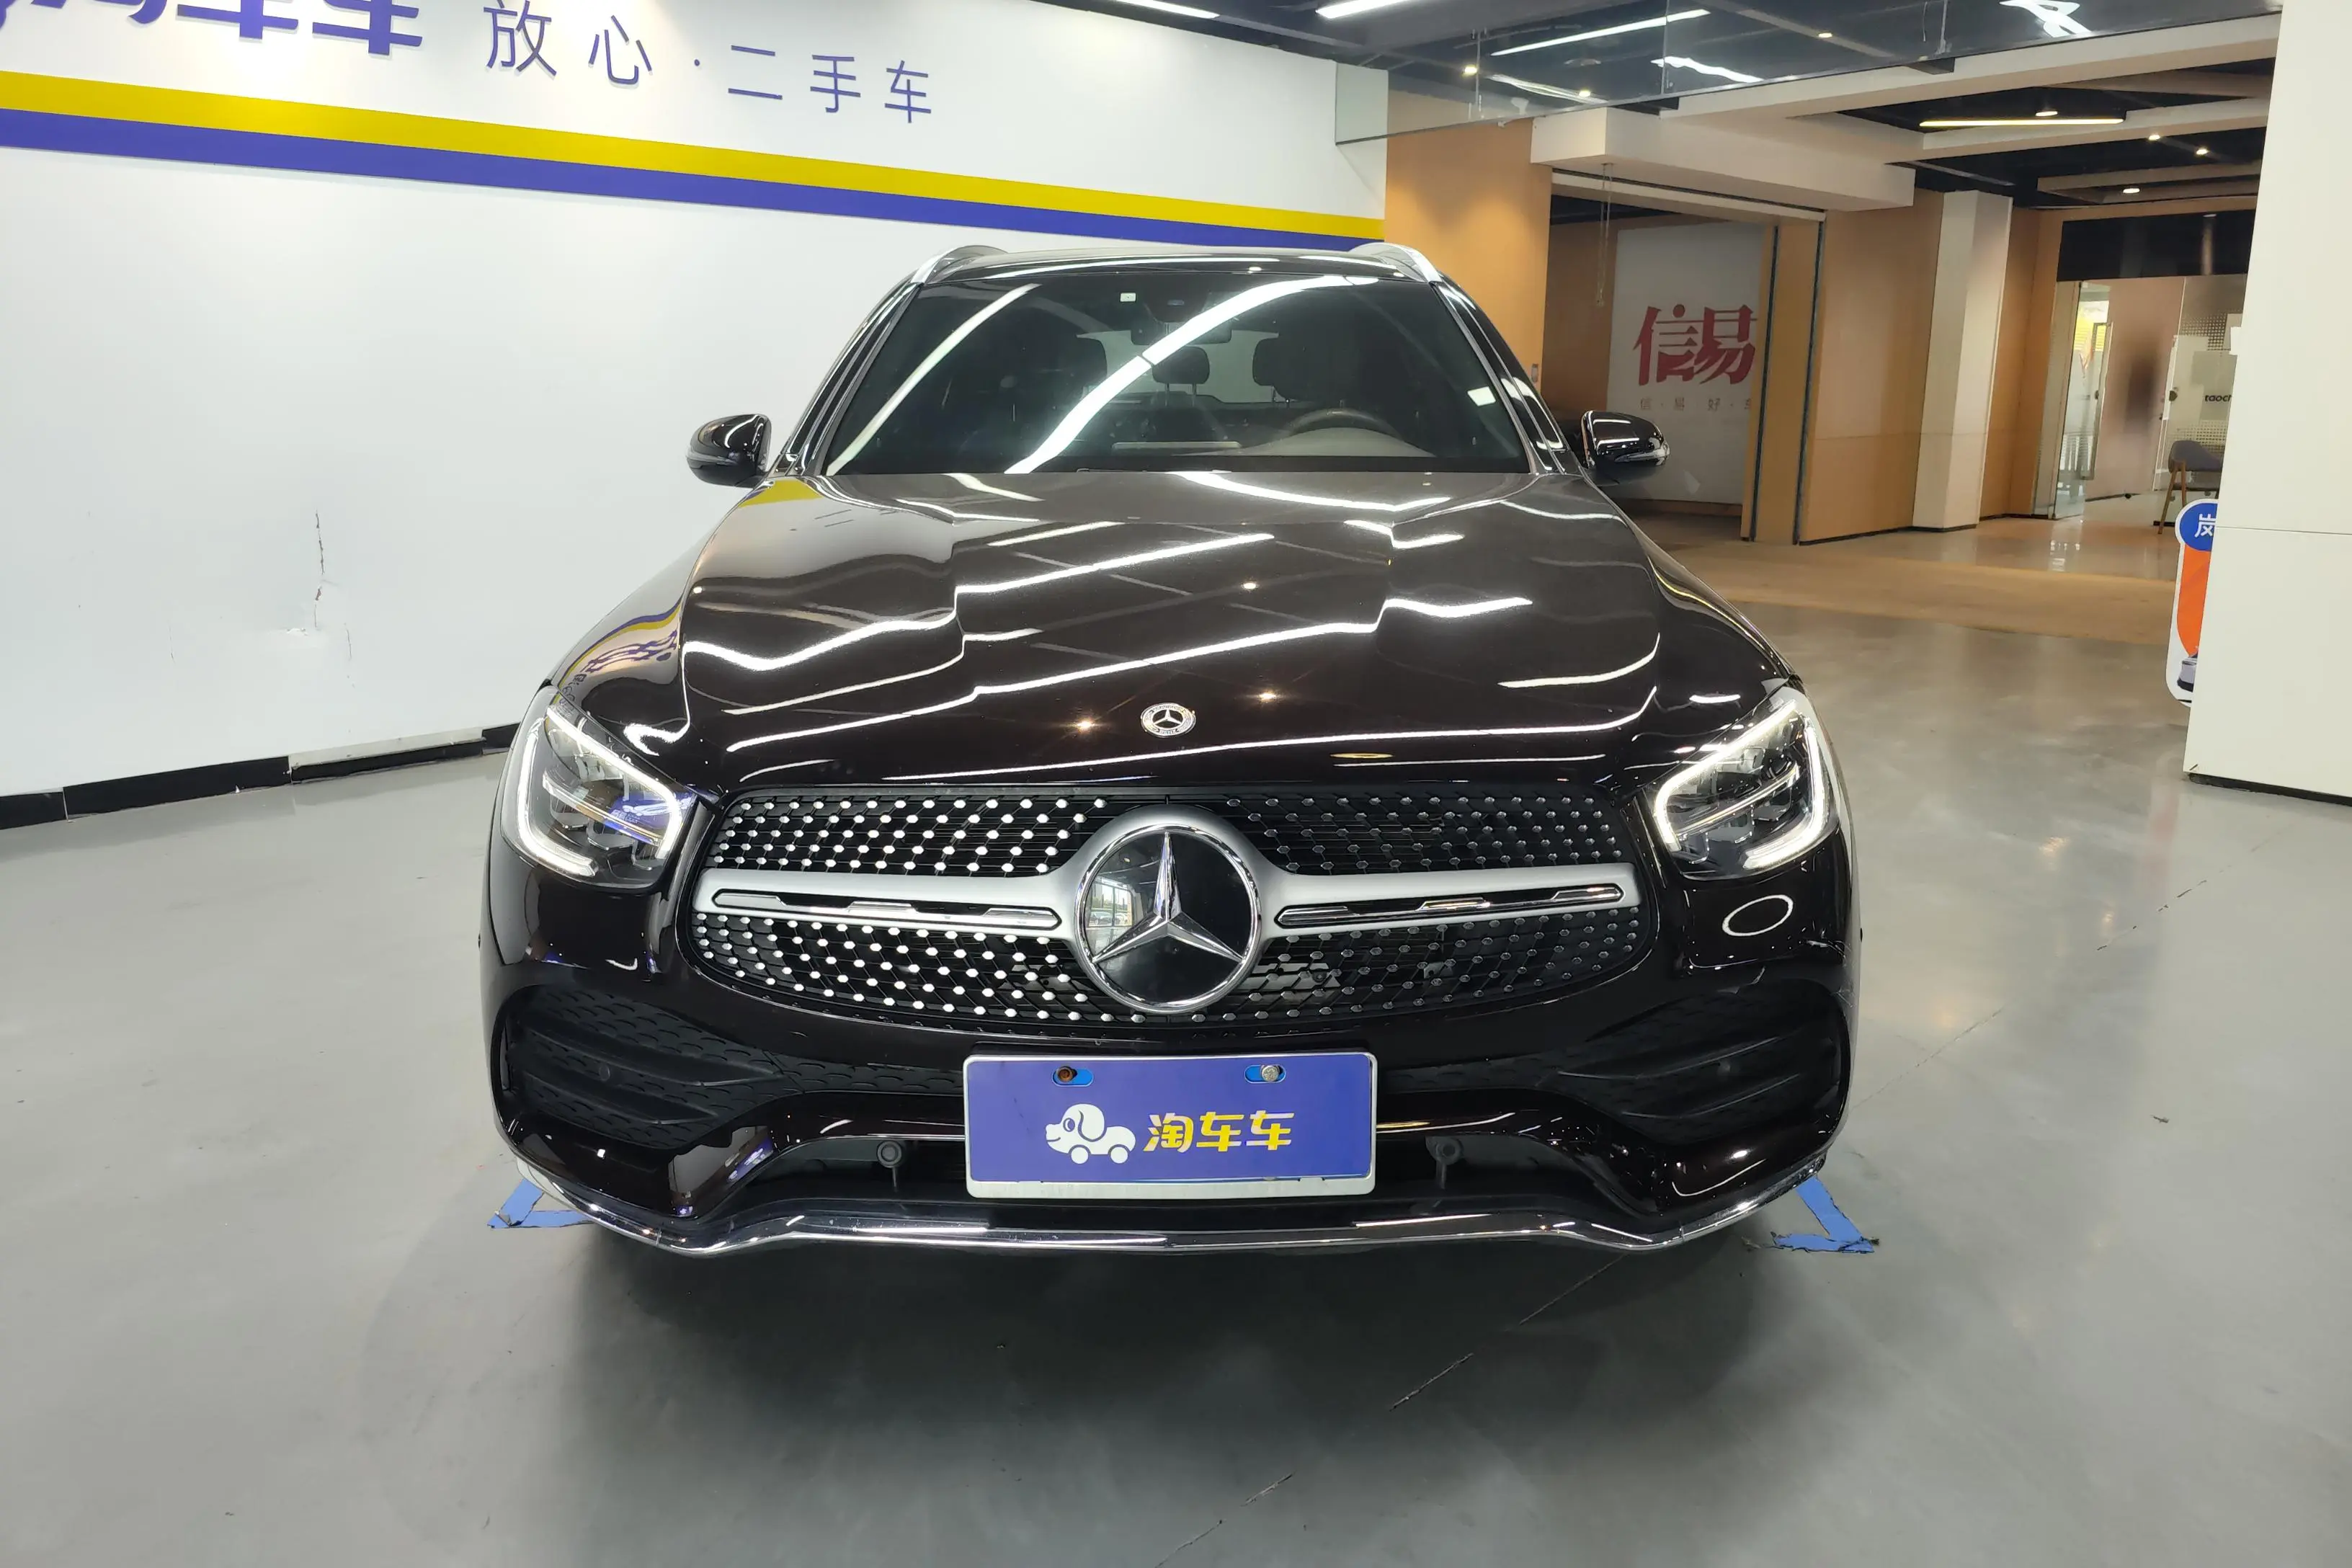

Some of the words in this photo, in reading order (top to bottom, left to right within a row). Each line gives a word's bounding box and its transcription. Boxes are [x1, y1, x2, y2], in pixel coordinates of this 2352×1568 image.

[1633, 304, 1758, 386] 信易
[1143, 1109, 1296, 1154] 淘车车
